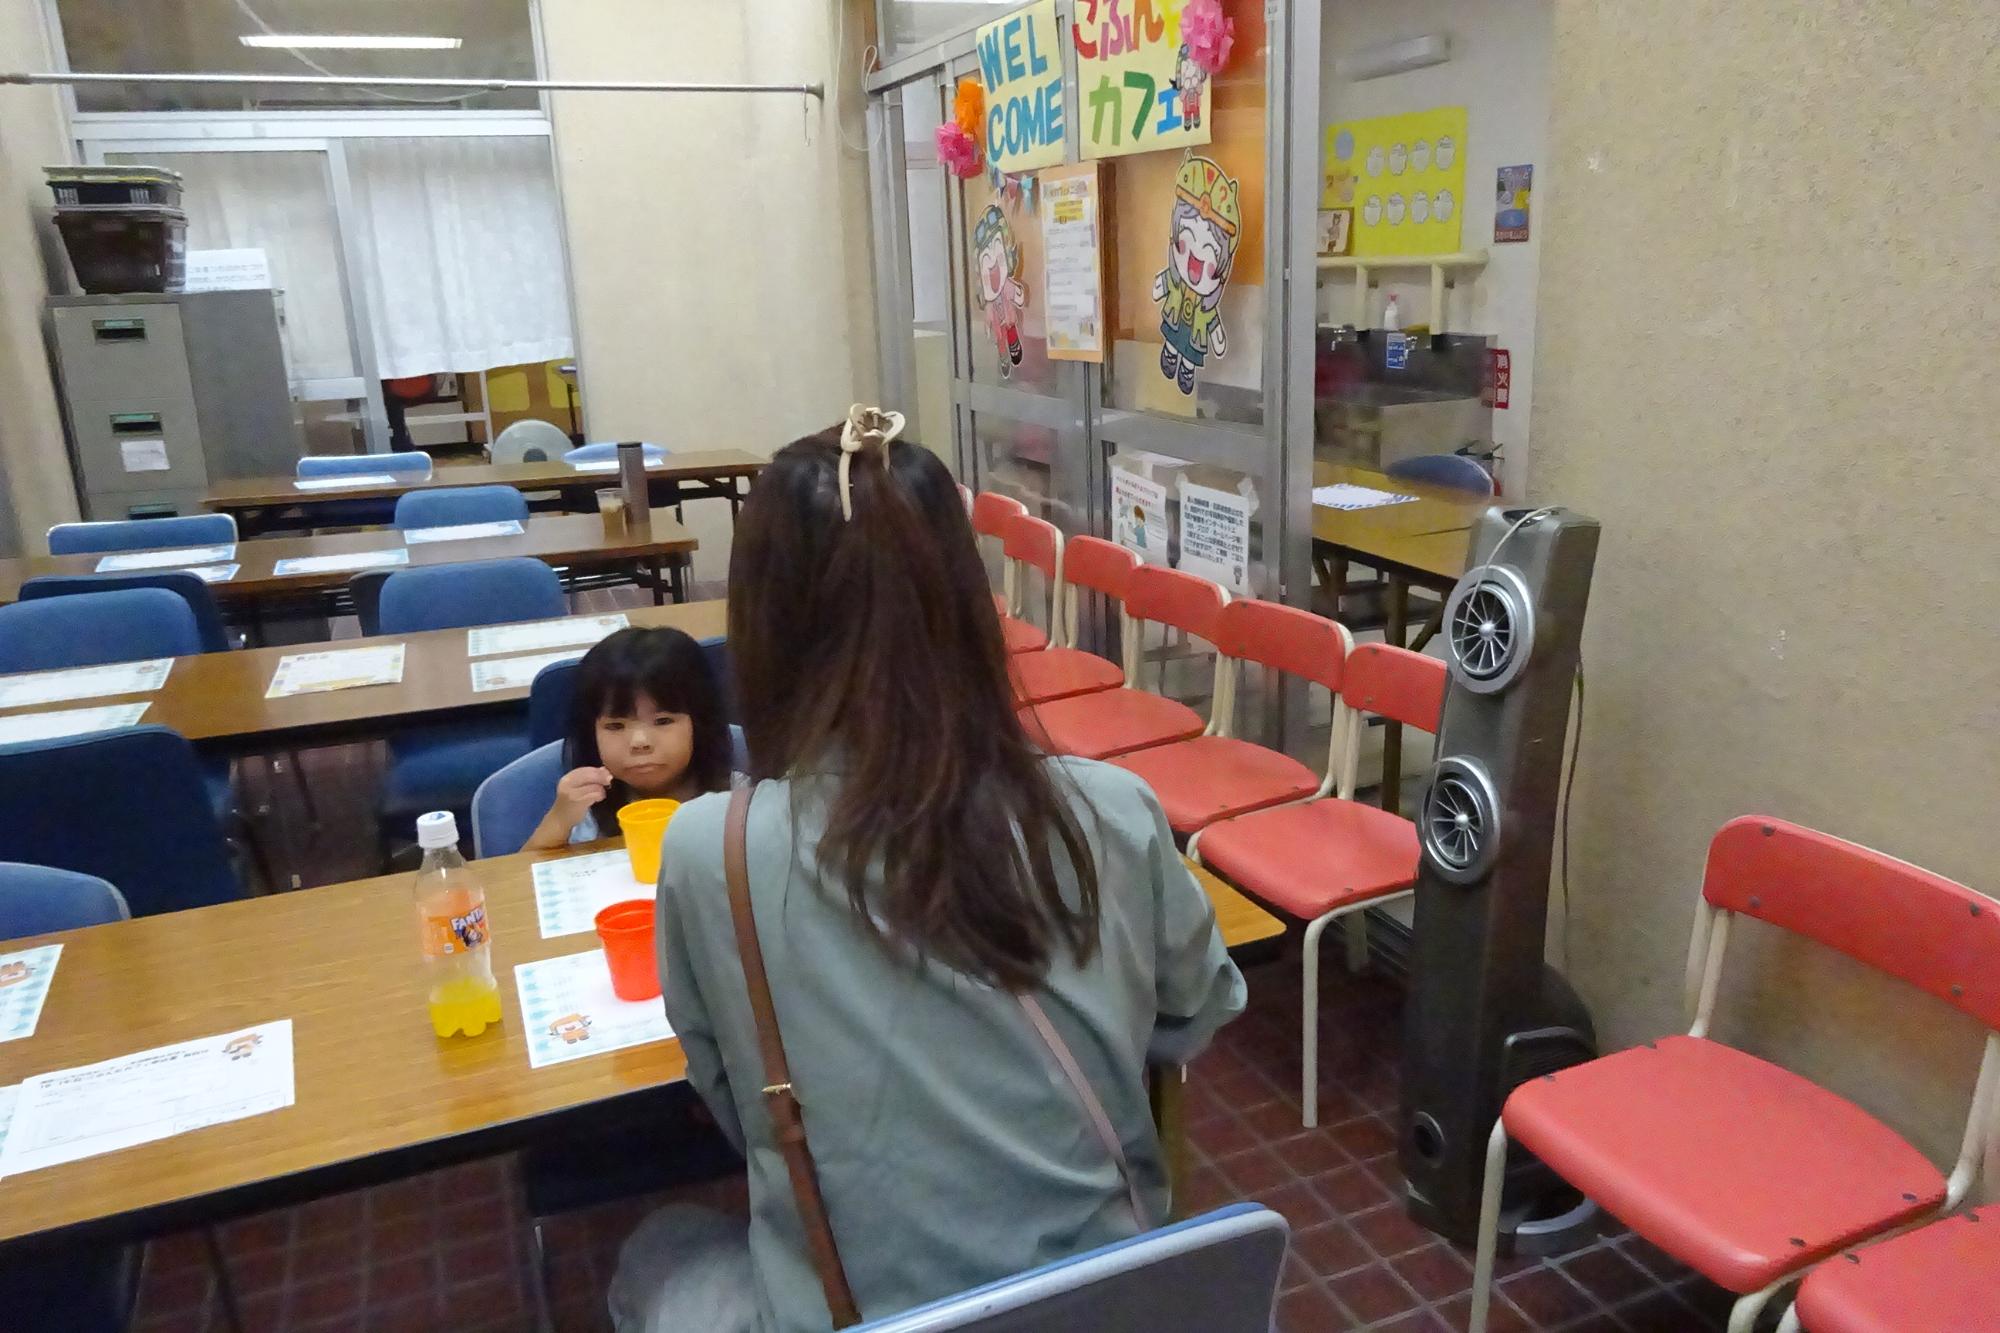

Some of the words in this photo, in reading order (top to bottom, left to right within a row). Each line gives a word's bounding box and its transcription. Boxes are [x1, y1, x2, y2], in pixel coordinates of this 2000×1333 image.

[978, 15, 1048, 94] WEL
[988, 79, 1064, 162] COME
[1089, 71, 1183, 147] カフェ
